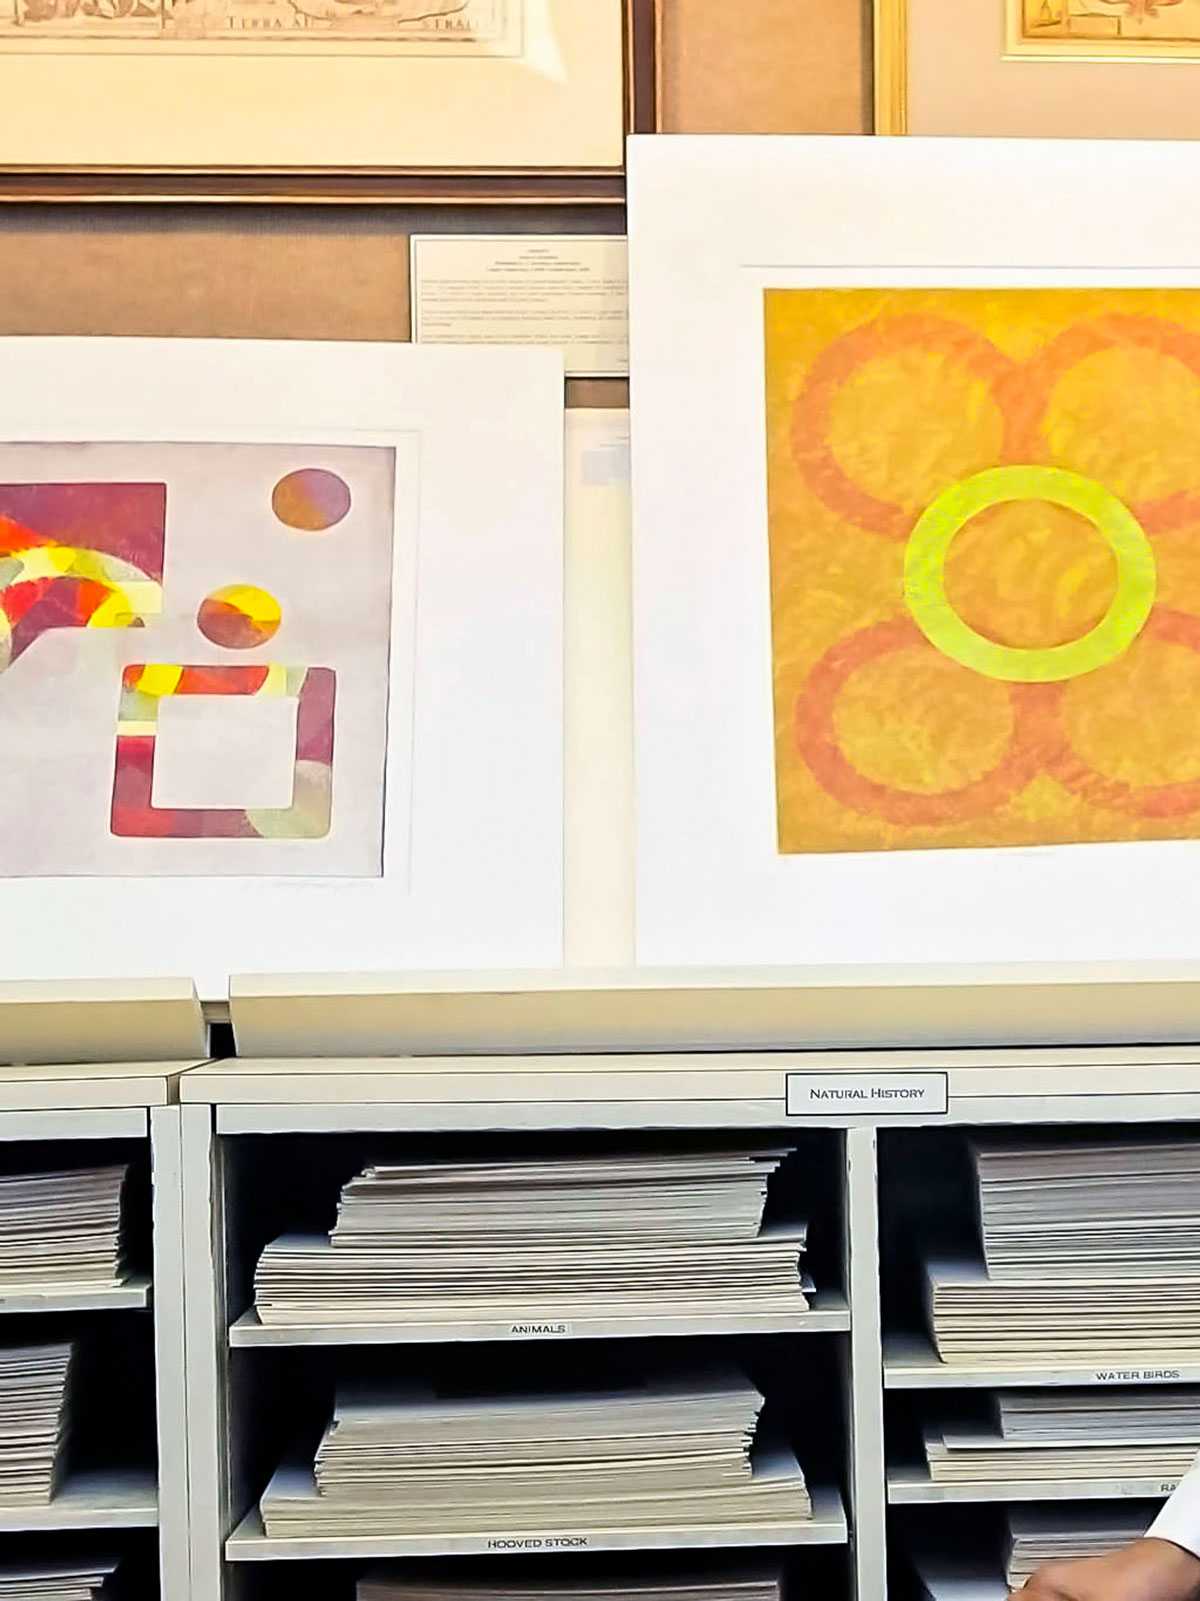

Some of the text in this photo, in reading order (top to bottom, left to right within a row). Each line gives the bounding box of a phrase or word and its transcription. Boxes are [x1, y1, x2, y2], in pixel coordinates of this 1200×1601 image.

[809, 1087, 925, 1100] NATURAL HISTORY
[511, 1324, 566, 1334] ANIMALS
[1096, 1369, 1181, 1381] WATER BIRDS
[487, 1537, 588, 1549] HOOVED STOCK
